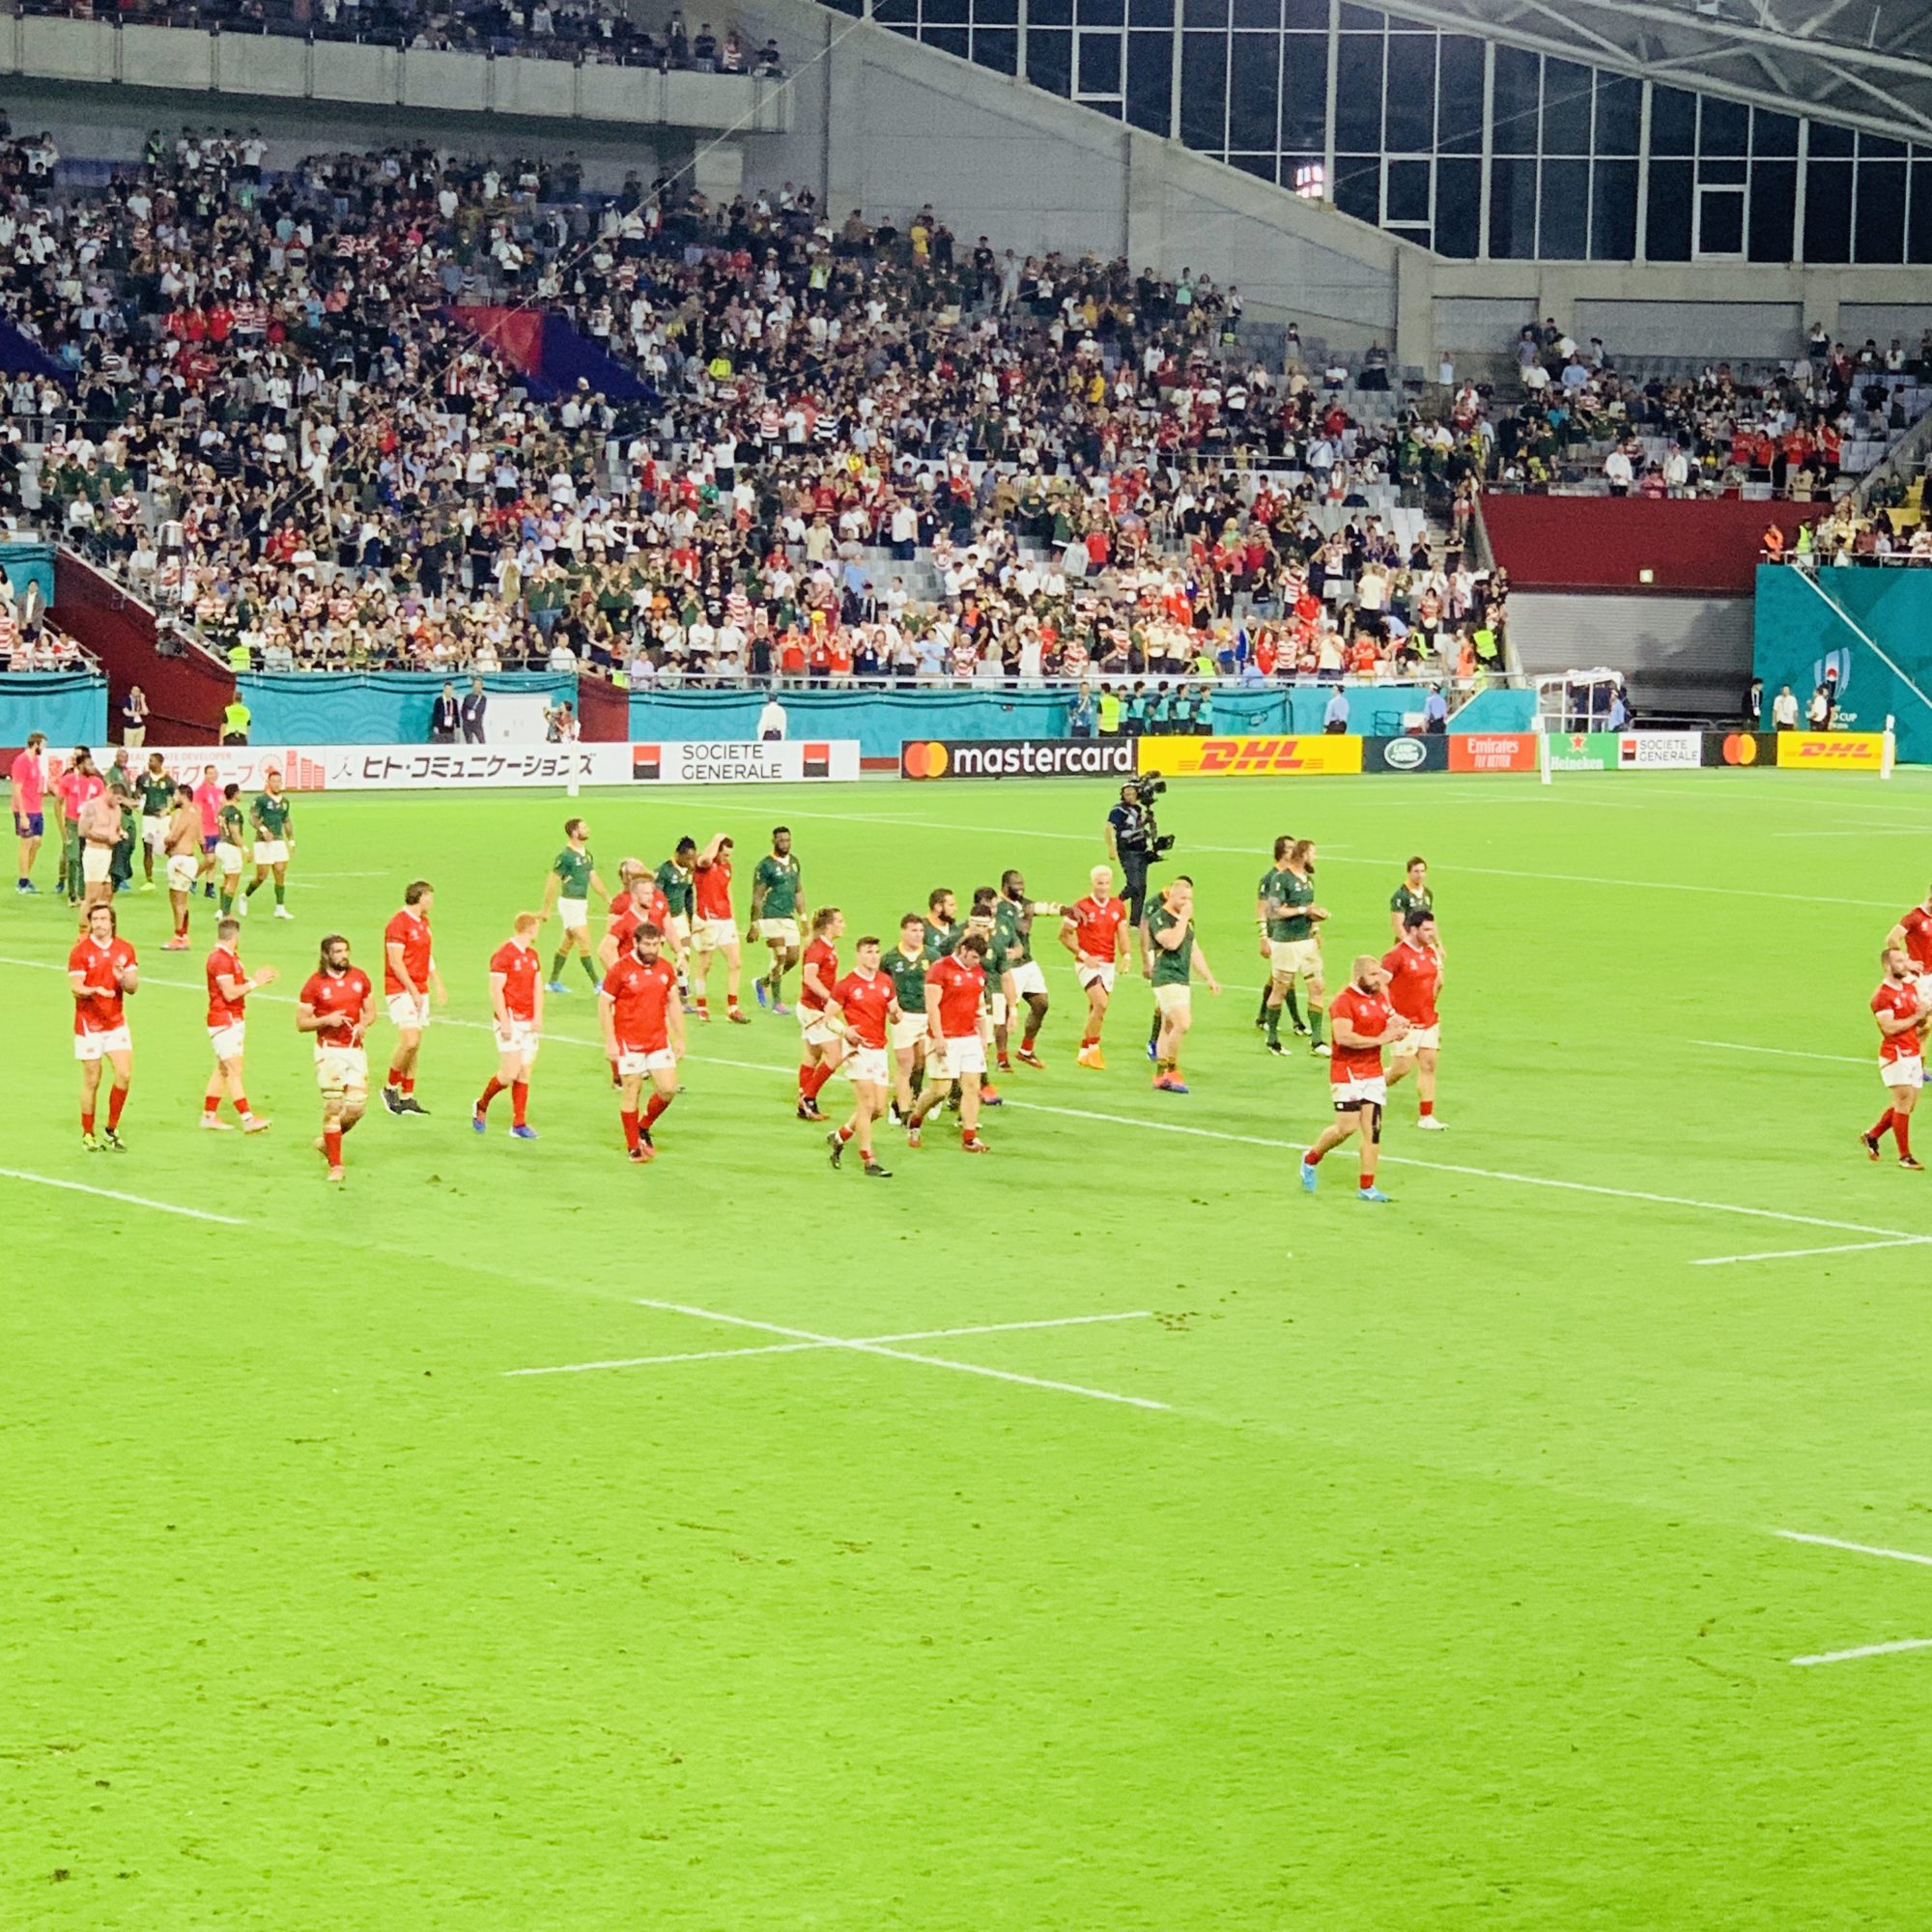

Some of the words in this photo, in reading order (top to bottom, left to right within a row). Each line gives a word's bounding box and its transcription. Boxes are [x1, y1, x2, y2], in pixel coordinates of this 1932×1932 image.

[682, 744, 764, 760] SOCIETE
[1467, 737, 1520, 754] Emirates
[1639, 739, 1688, 751] SOCIETE
[1799, 741, 1872, 758] DHL
[953, 739, 1133, 773] mastercard
[1198, 741, 1306, 769] DHL
[1549, 756, 1605, 770] Heineken
[1639, 751, 1698, 761] GENERALE
[681, 763, 782, 780] GENERALE
